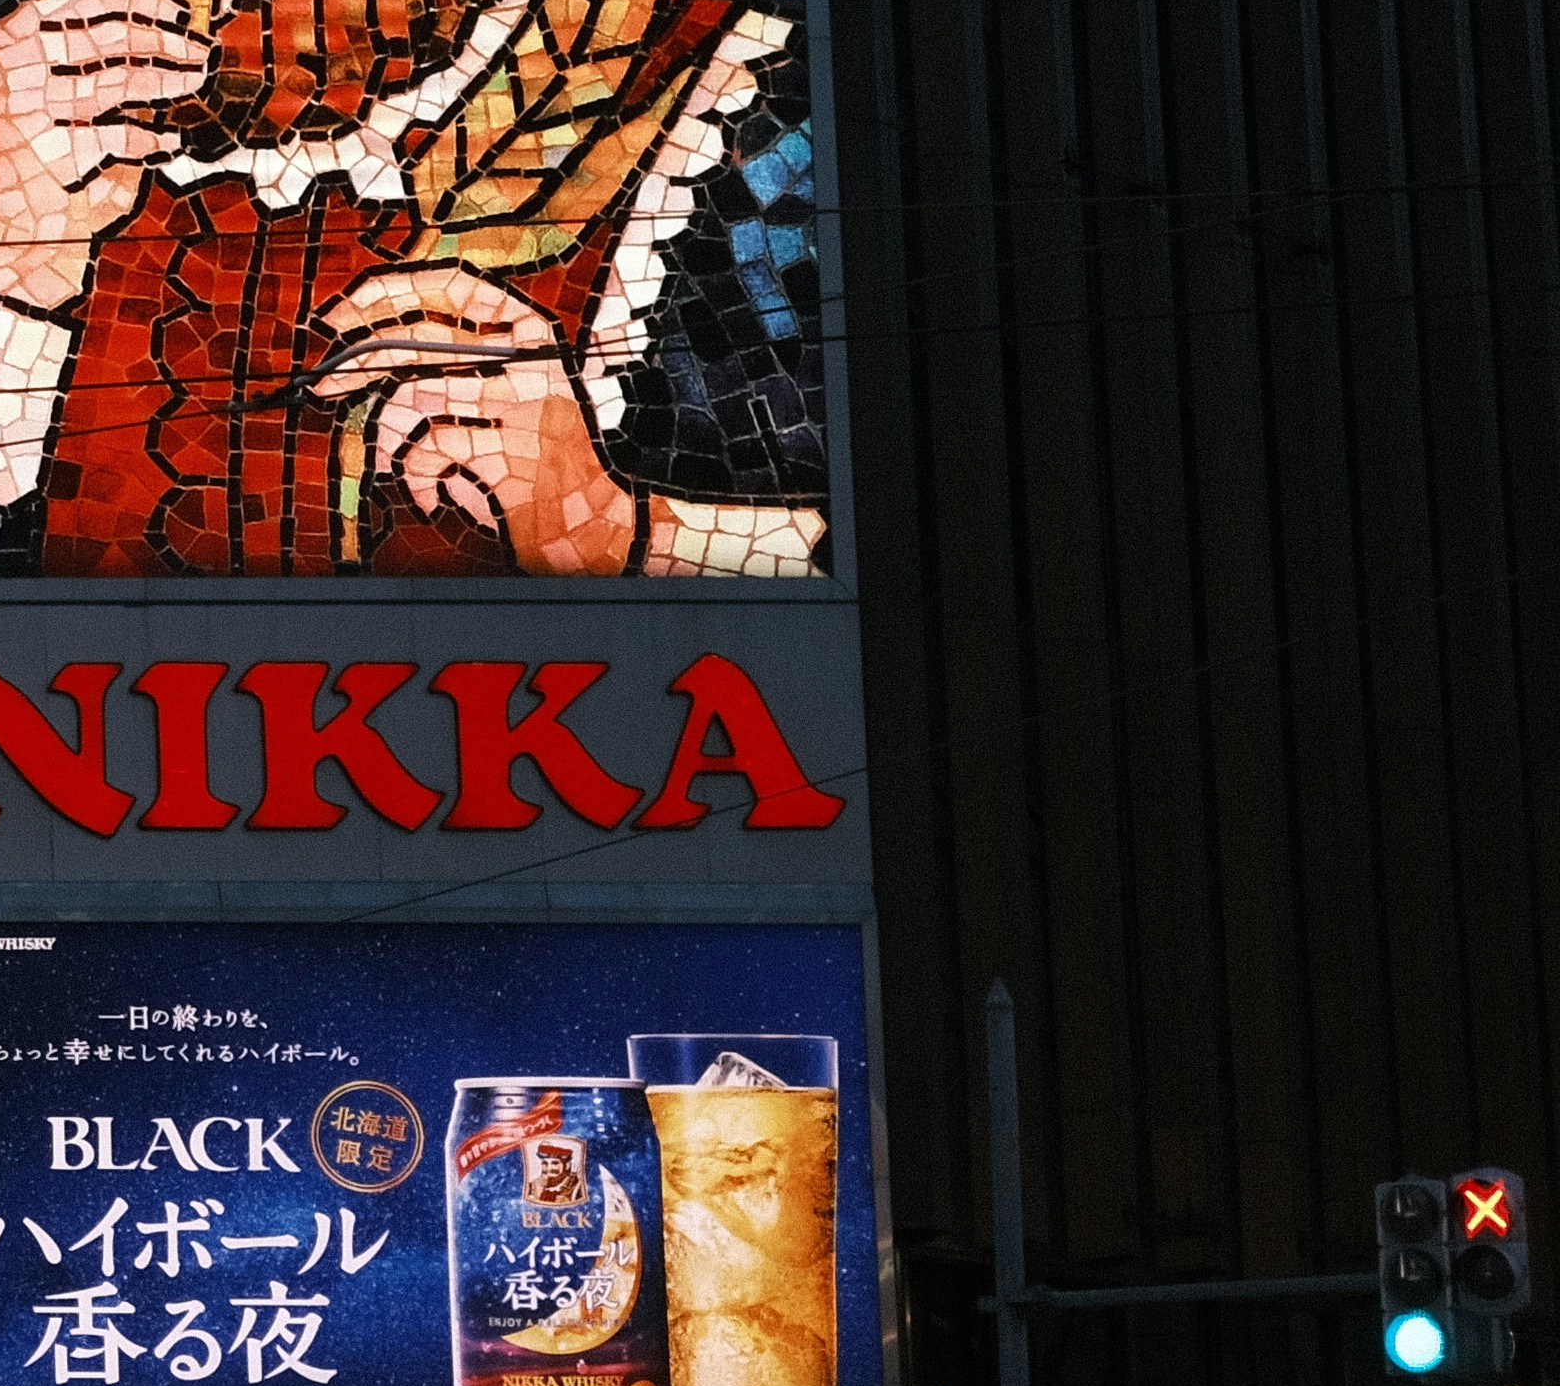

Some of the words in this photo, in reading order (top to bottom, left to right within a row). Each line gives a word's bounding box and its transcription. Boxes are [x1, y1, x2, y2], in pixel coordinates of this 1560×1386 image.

[98, 1004, 268, 1031] 一日の終わりを、
[330, 1106, 408, 1142] 北海道
[47, 1116, 302, 1173] BLACK
[336, 1140, 393, 1172] 限定
[522, 1211, 593, 1229] BLACK
[484, 1236, 633, 1269] ハイボール
[502, 1271, 619, 1311] 香る夜
[23, 1280, 338, 1385] 香る夜
